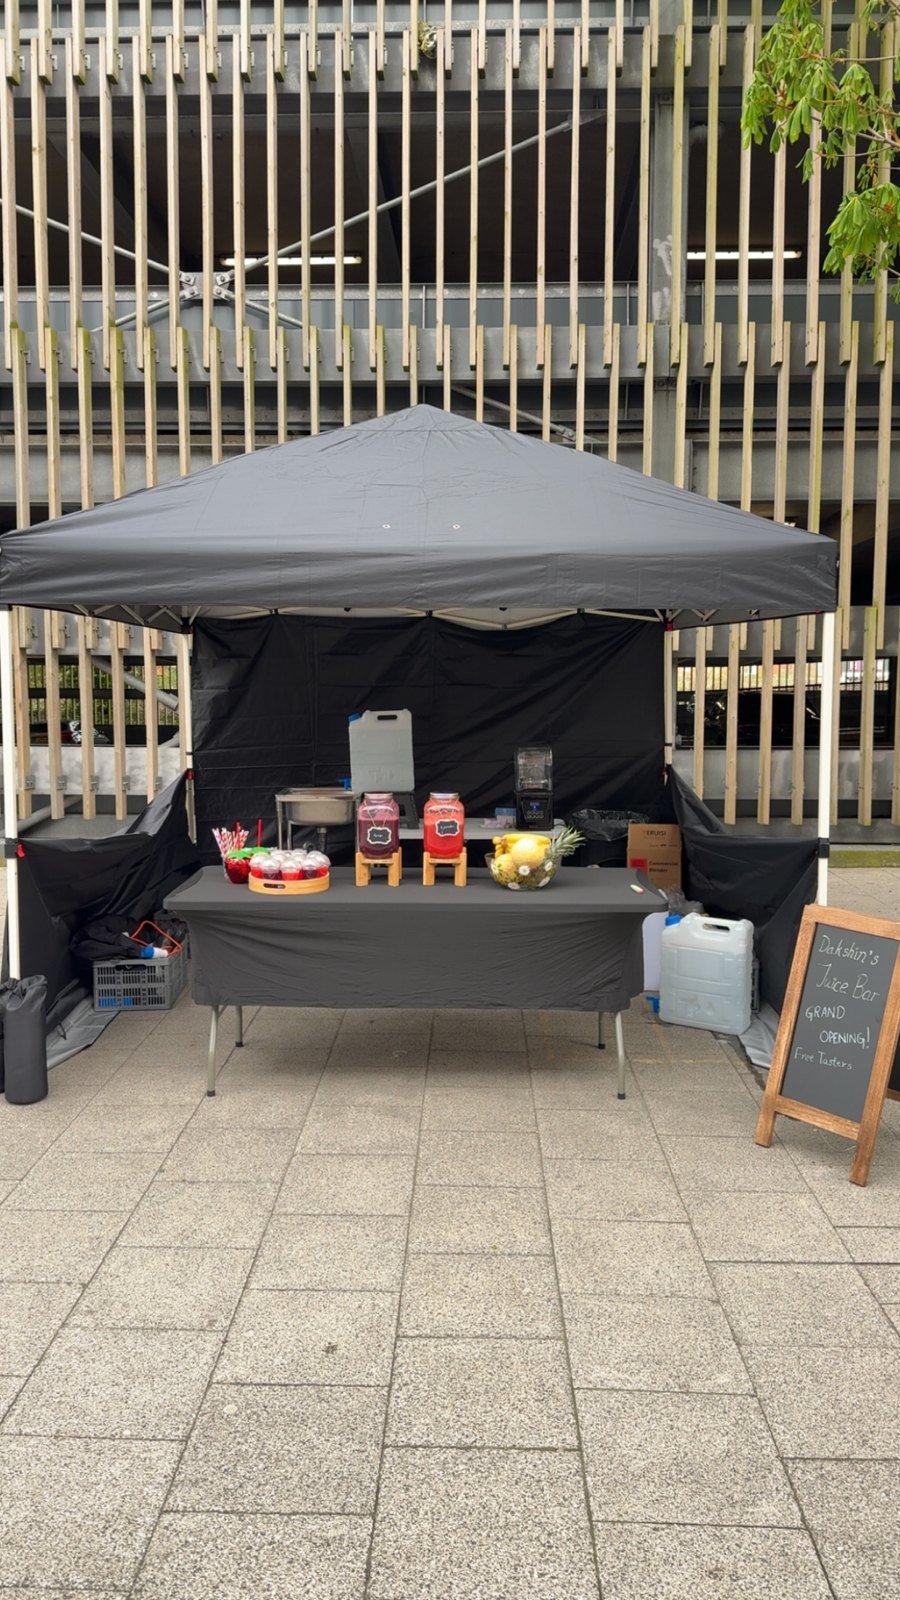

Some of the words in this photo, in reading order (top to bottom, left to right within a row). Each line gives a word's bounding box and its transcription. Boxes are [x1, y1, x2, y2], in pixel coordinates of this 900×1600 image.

[819, 934, 880, 966] Dakshin's
[816, 963, 849, 994] Juice
[852, 973, 881, 1002] Bar
[805, 1005, 846, 1022] GRAND
[819, 1026, 870, 1049] OPENING!
[794, 1046, 814, 1062] Free
[818, 1050, 853, 1070] Tasters
